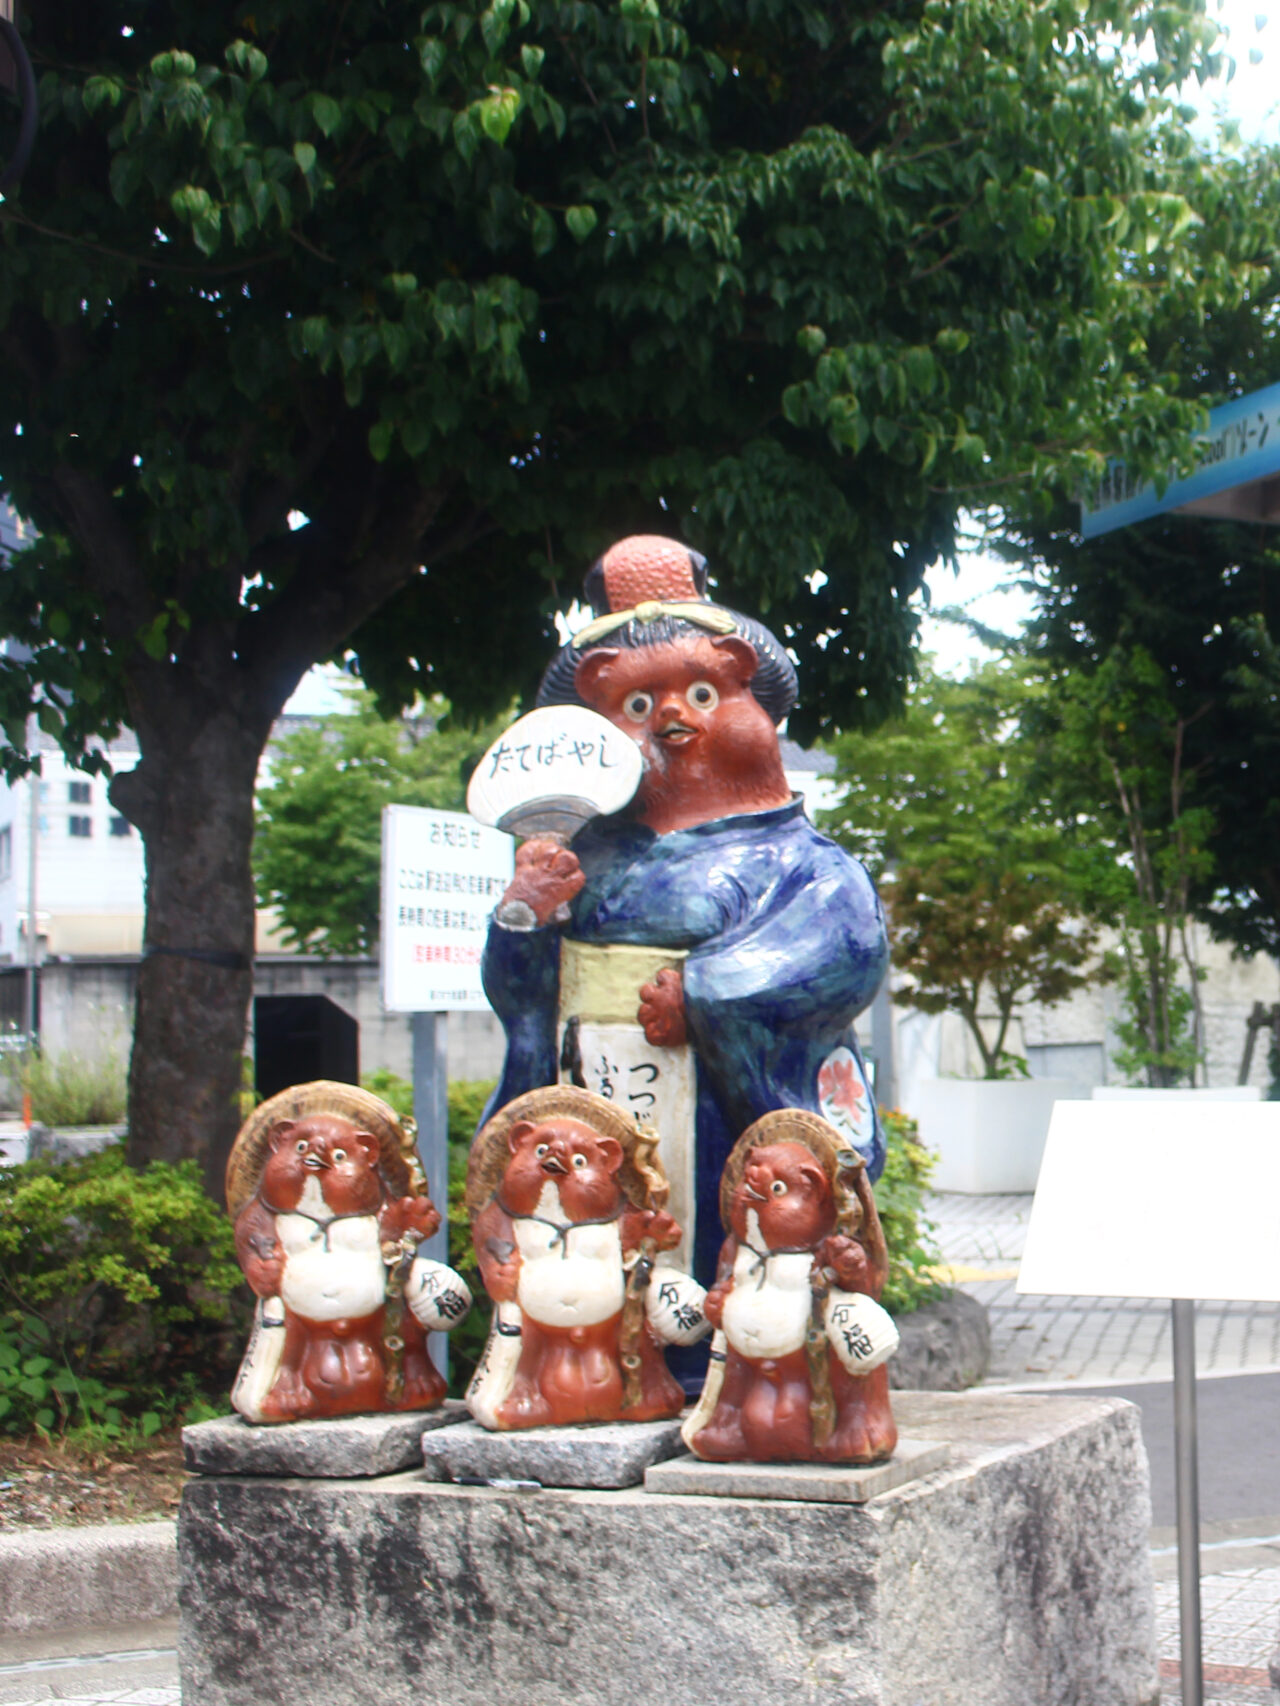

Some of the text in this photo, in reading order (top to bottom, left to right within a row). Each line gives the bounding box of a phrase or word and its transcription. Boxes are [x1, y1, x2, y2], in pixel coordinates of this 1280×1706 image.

[490, 733, 617, 779] たてばやし
[430, 821, 481, 849] お知らせ
[420, 1270, 467, 1320] 分福
[659, 1280, 703, 1331] 分福
[831, 1303, 874, 1360] 分福
